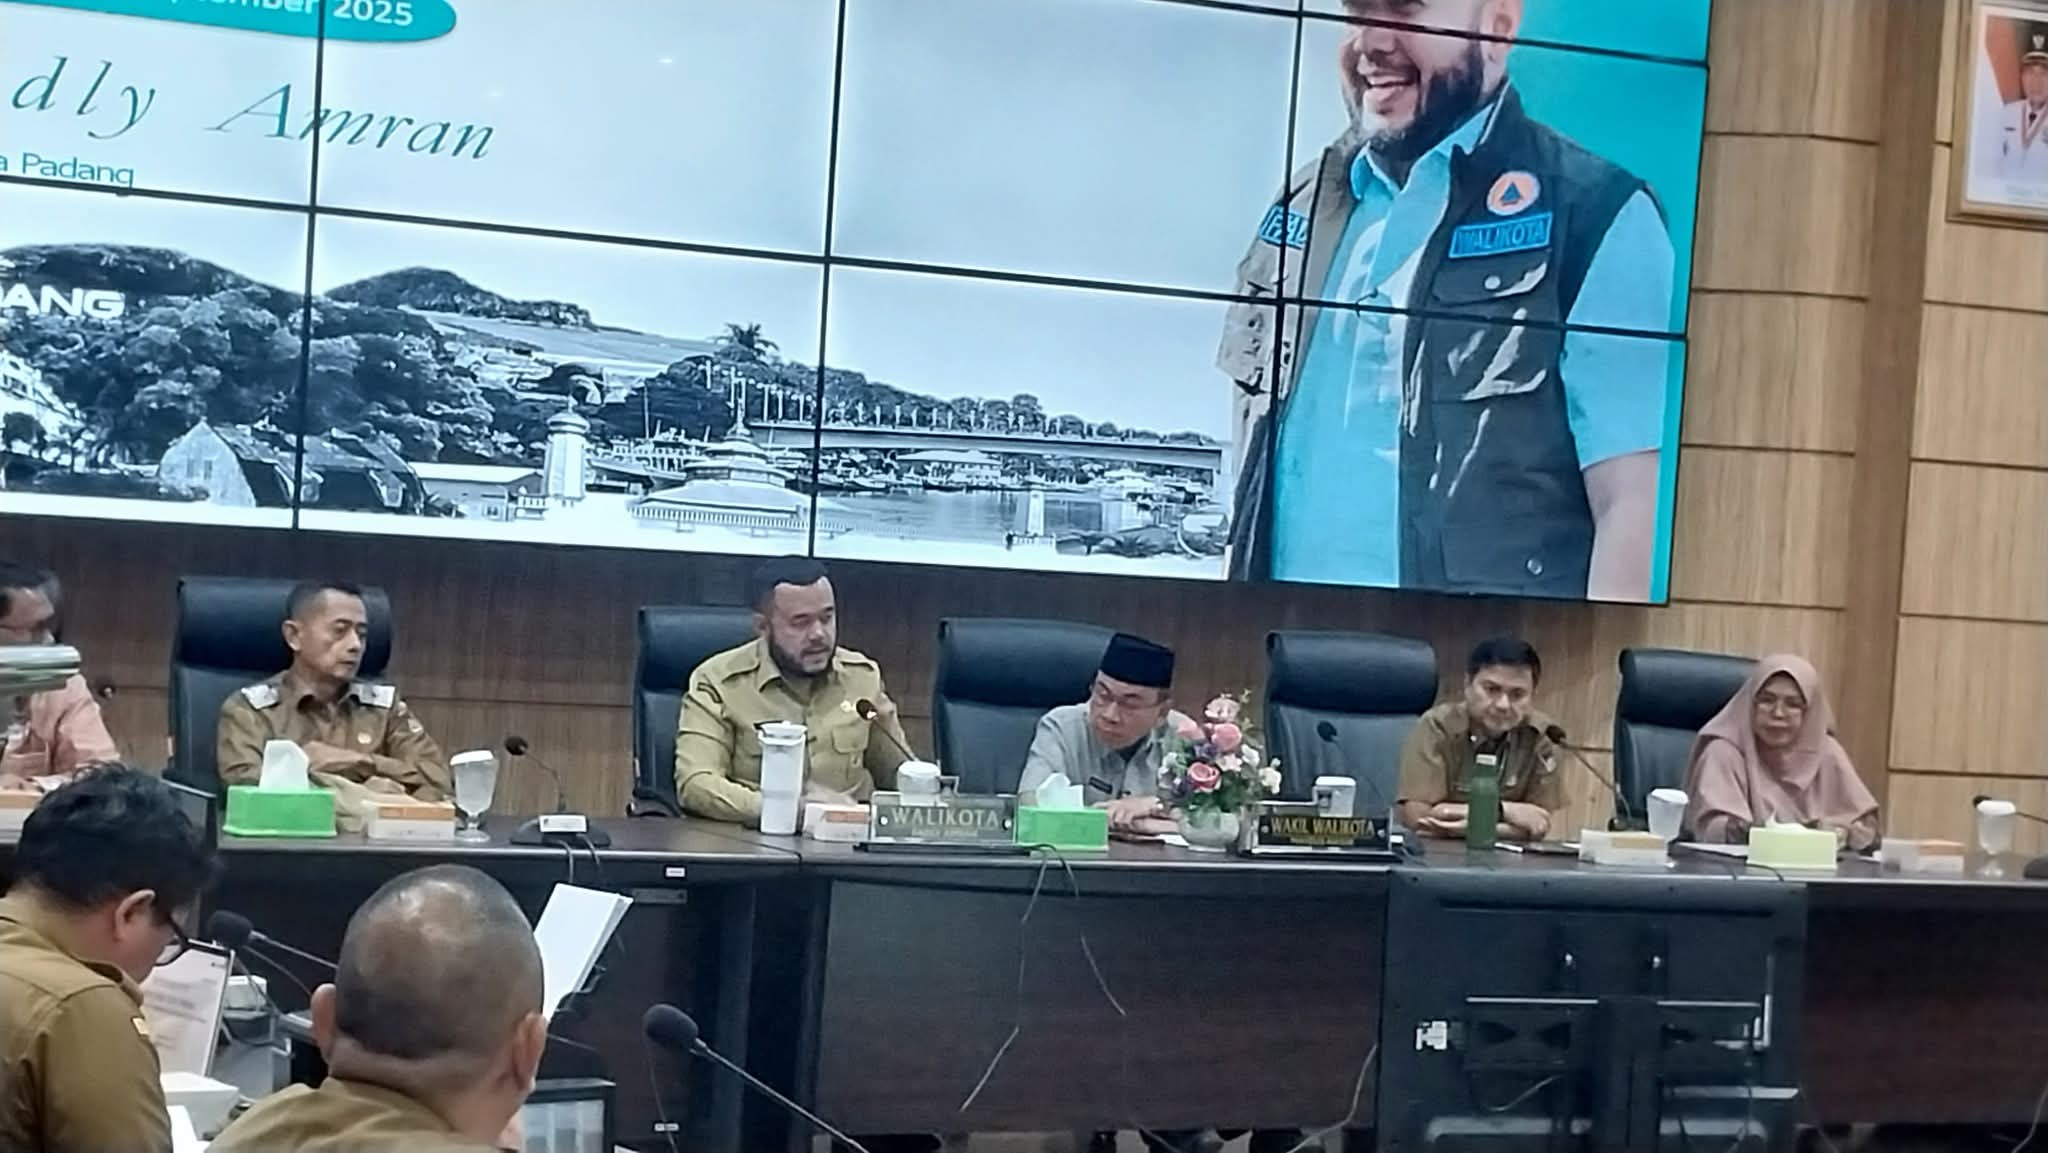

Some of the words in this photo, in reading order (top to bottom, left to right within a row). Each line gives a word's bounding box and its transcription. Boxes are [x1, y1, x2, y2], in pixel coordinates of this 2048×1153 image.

[332, 0, 414, 26] 2025
[203, 83, 494, 160] Amran
[22, 152, 135, 189] Padang
[0, 283, 126, 319] ANG
[891, 807, 1000, 830] WALIKOTA
[1271, 817, 1309, 833] WAKIL
[1312, 818, 1375, 836] WALIKOTA
